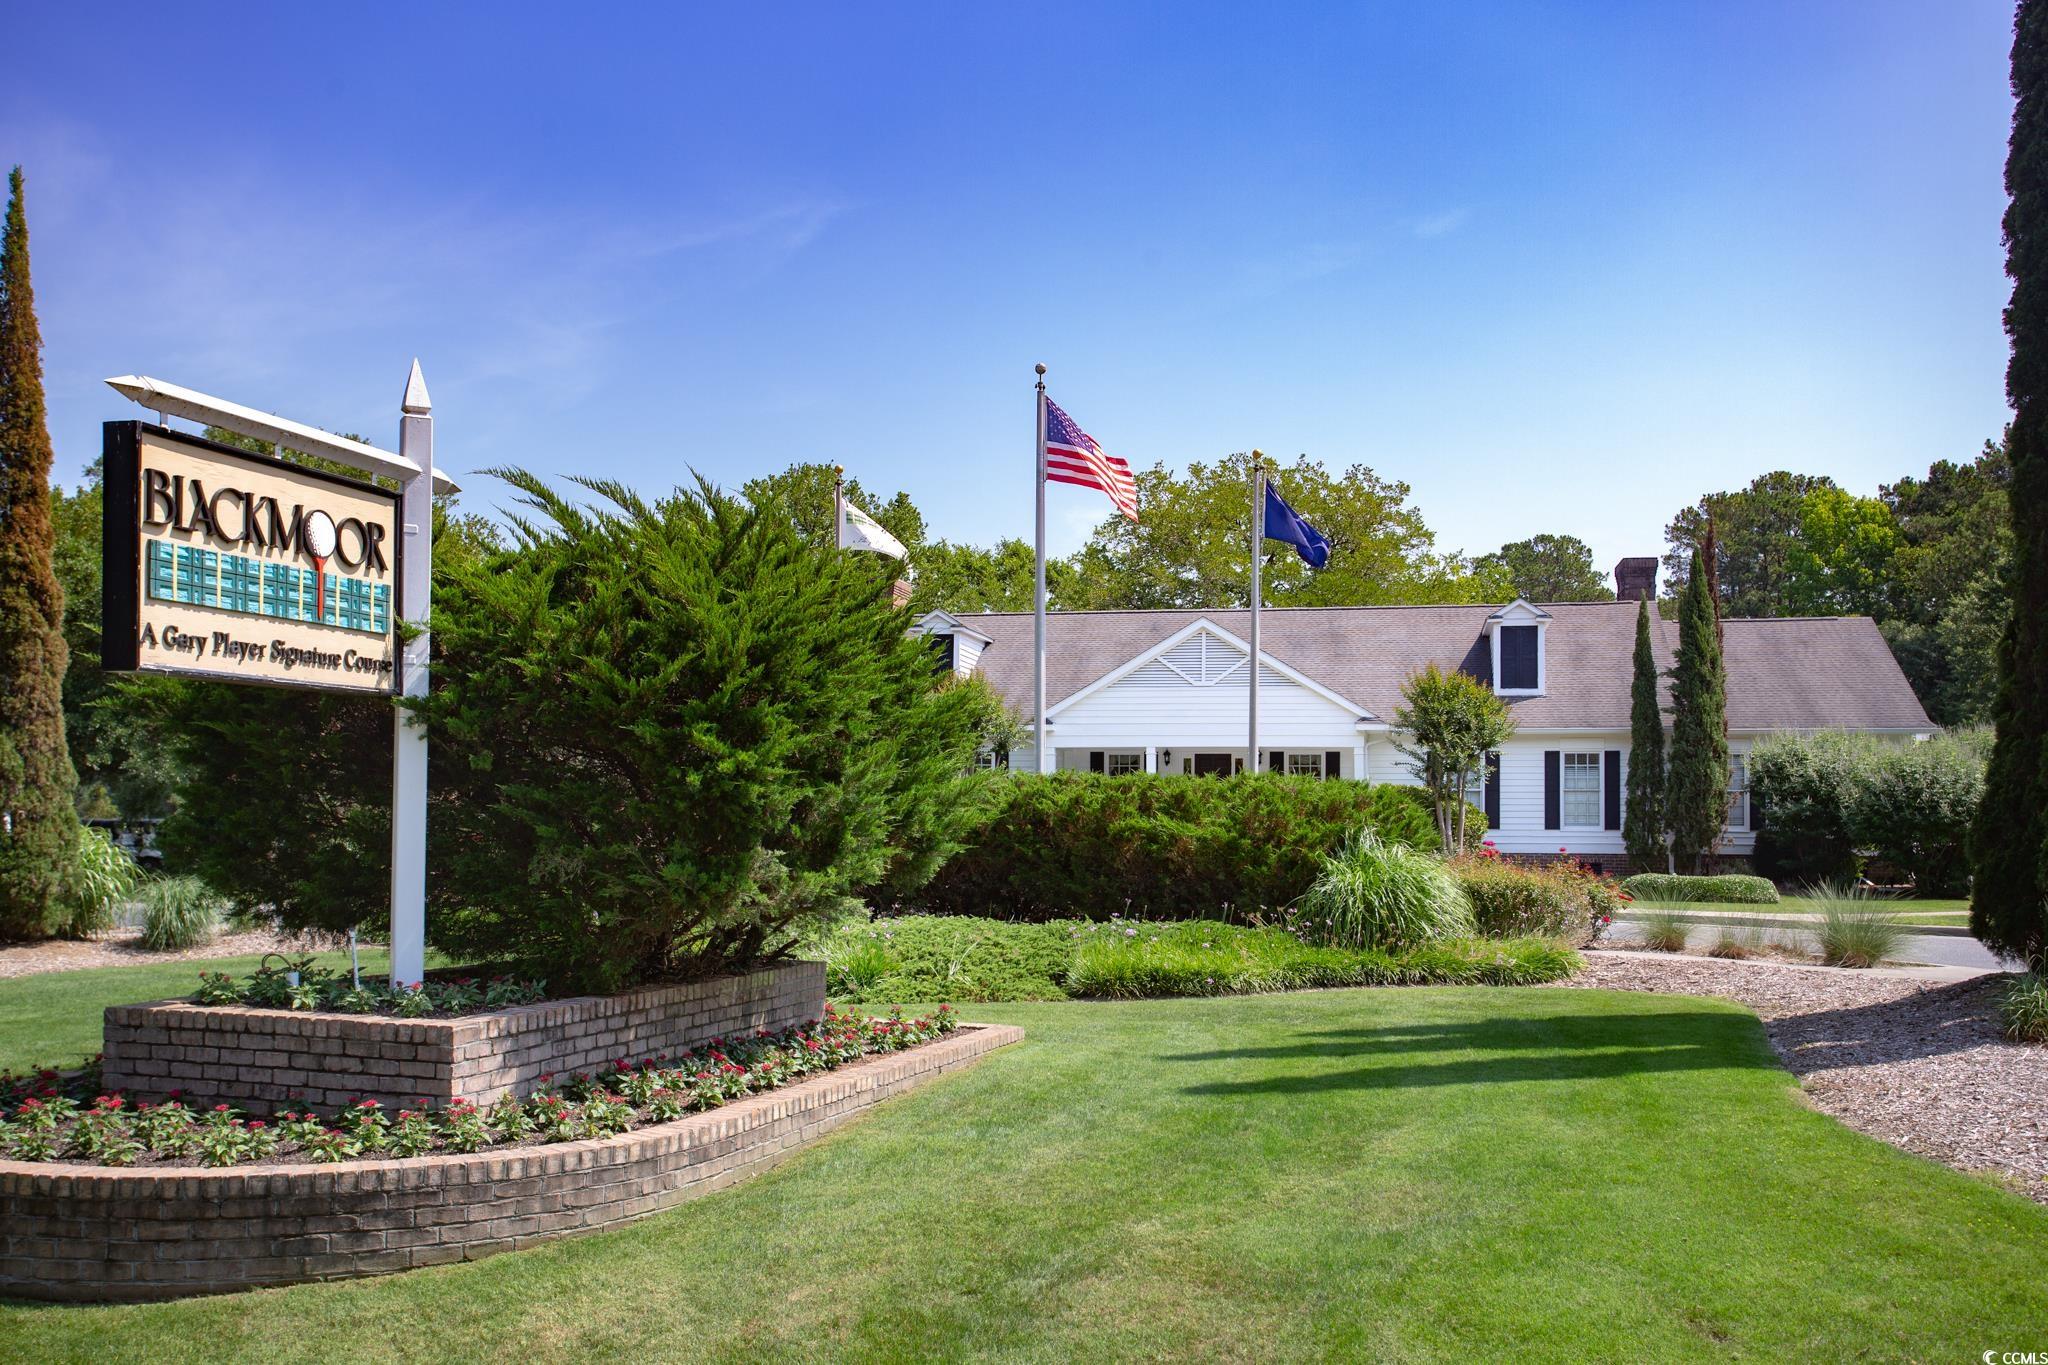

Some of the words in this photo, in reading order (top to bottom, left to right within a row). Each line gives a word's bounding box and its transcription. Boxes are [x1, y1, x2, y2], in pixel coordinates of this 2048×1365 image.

[144, 468, 388, 571] BLACKMOOR
[140, 622, 159, 645] A
[162, 625, 208, 661] Gary
[212, 631, 267, 665] Player
[271, 639, 342, 669] Signature
[344, 649, 393, 673] Course
